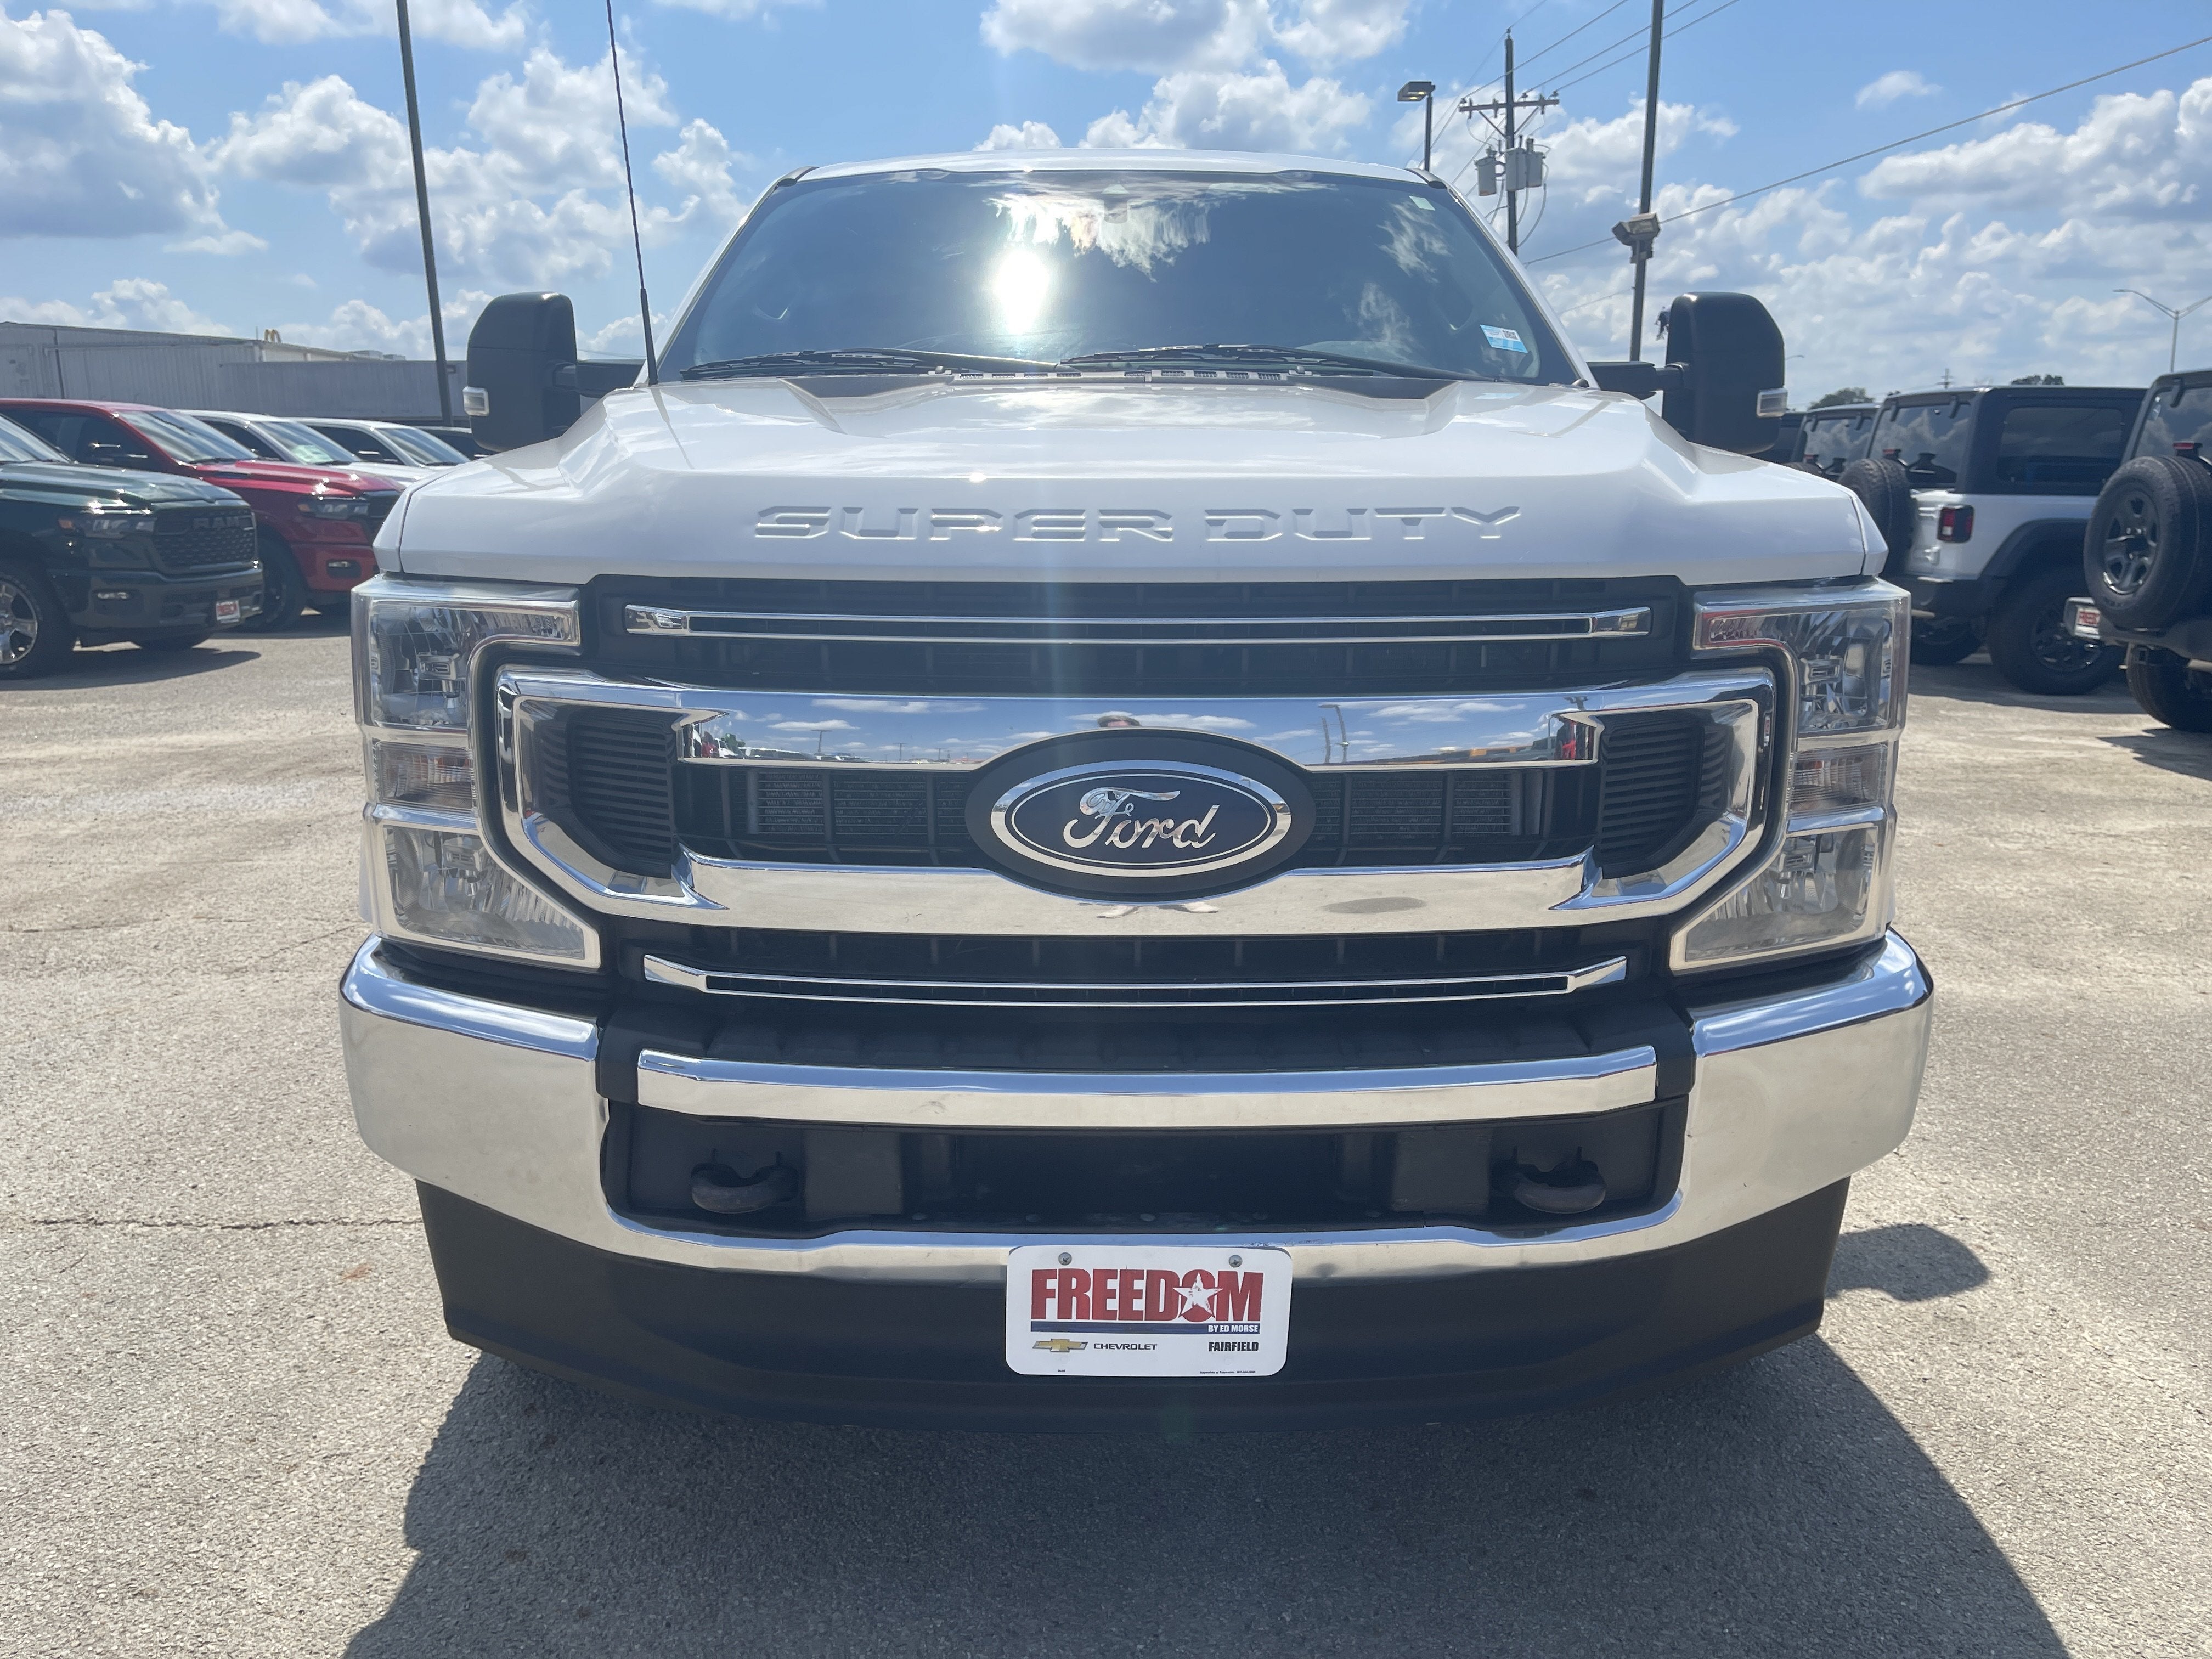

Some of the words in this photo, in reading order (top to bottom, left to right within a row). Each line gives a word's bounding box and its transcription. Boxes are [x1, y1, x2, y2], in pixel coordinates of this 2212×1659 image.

[755, 506, 1172, 543] SUPER
[1205, 506, 1521, 543] DUTY
[1063, 787, 1220, 849] Ford
[1031, 1268, 1264, 1323] FREEDOM
[1209, 1341, 1259, 1352] FAIRFIELD
